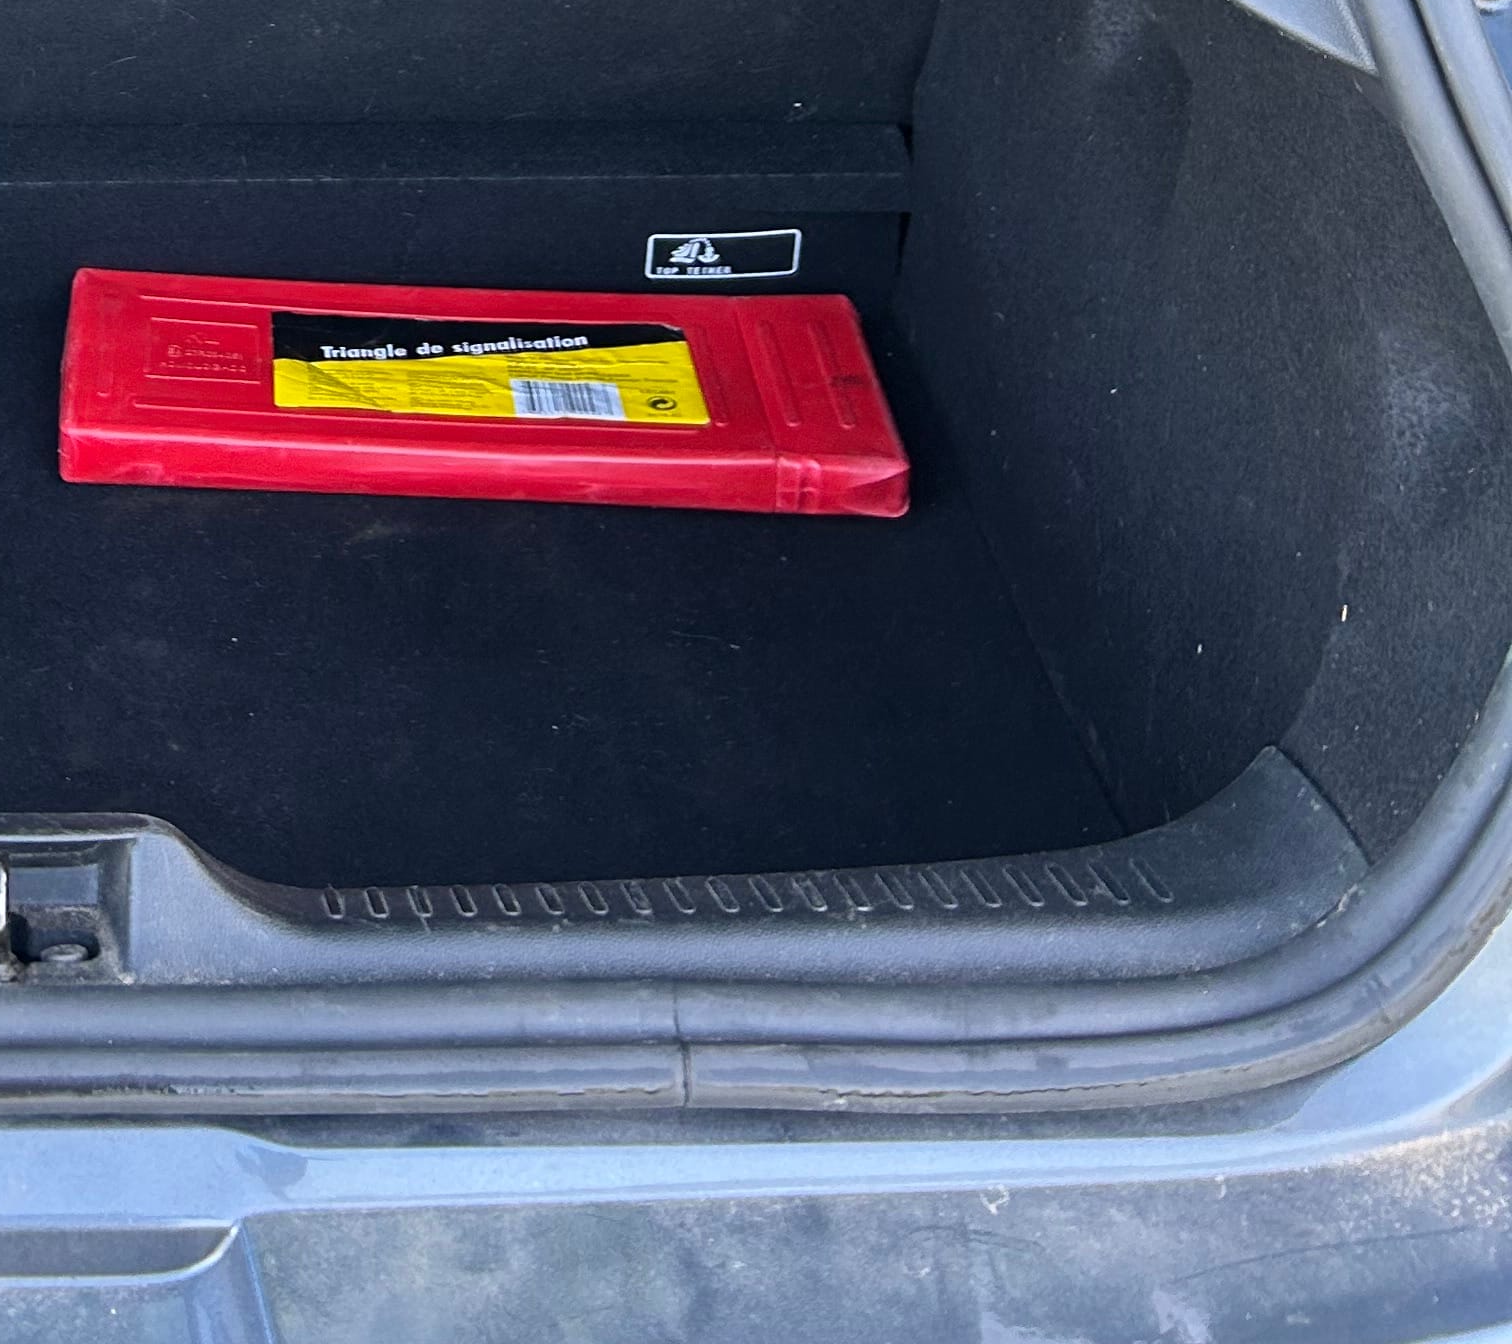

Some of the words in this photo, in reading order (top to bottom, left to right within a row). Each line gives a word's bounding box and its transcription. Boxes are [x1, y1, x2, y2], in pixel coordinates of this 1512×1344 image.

[656, 266, 679, 275] TOP
[320, 344, 408, 361] Triangle
[415, 342, 444, 355] de
[452, 335, 588, 355] signalisation
